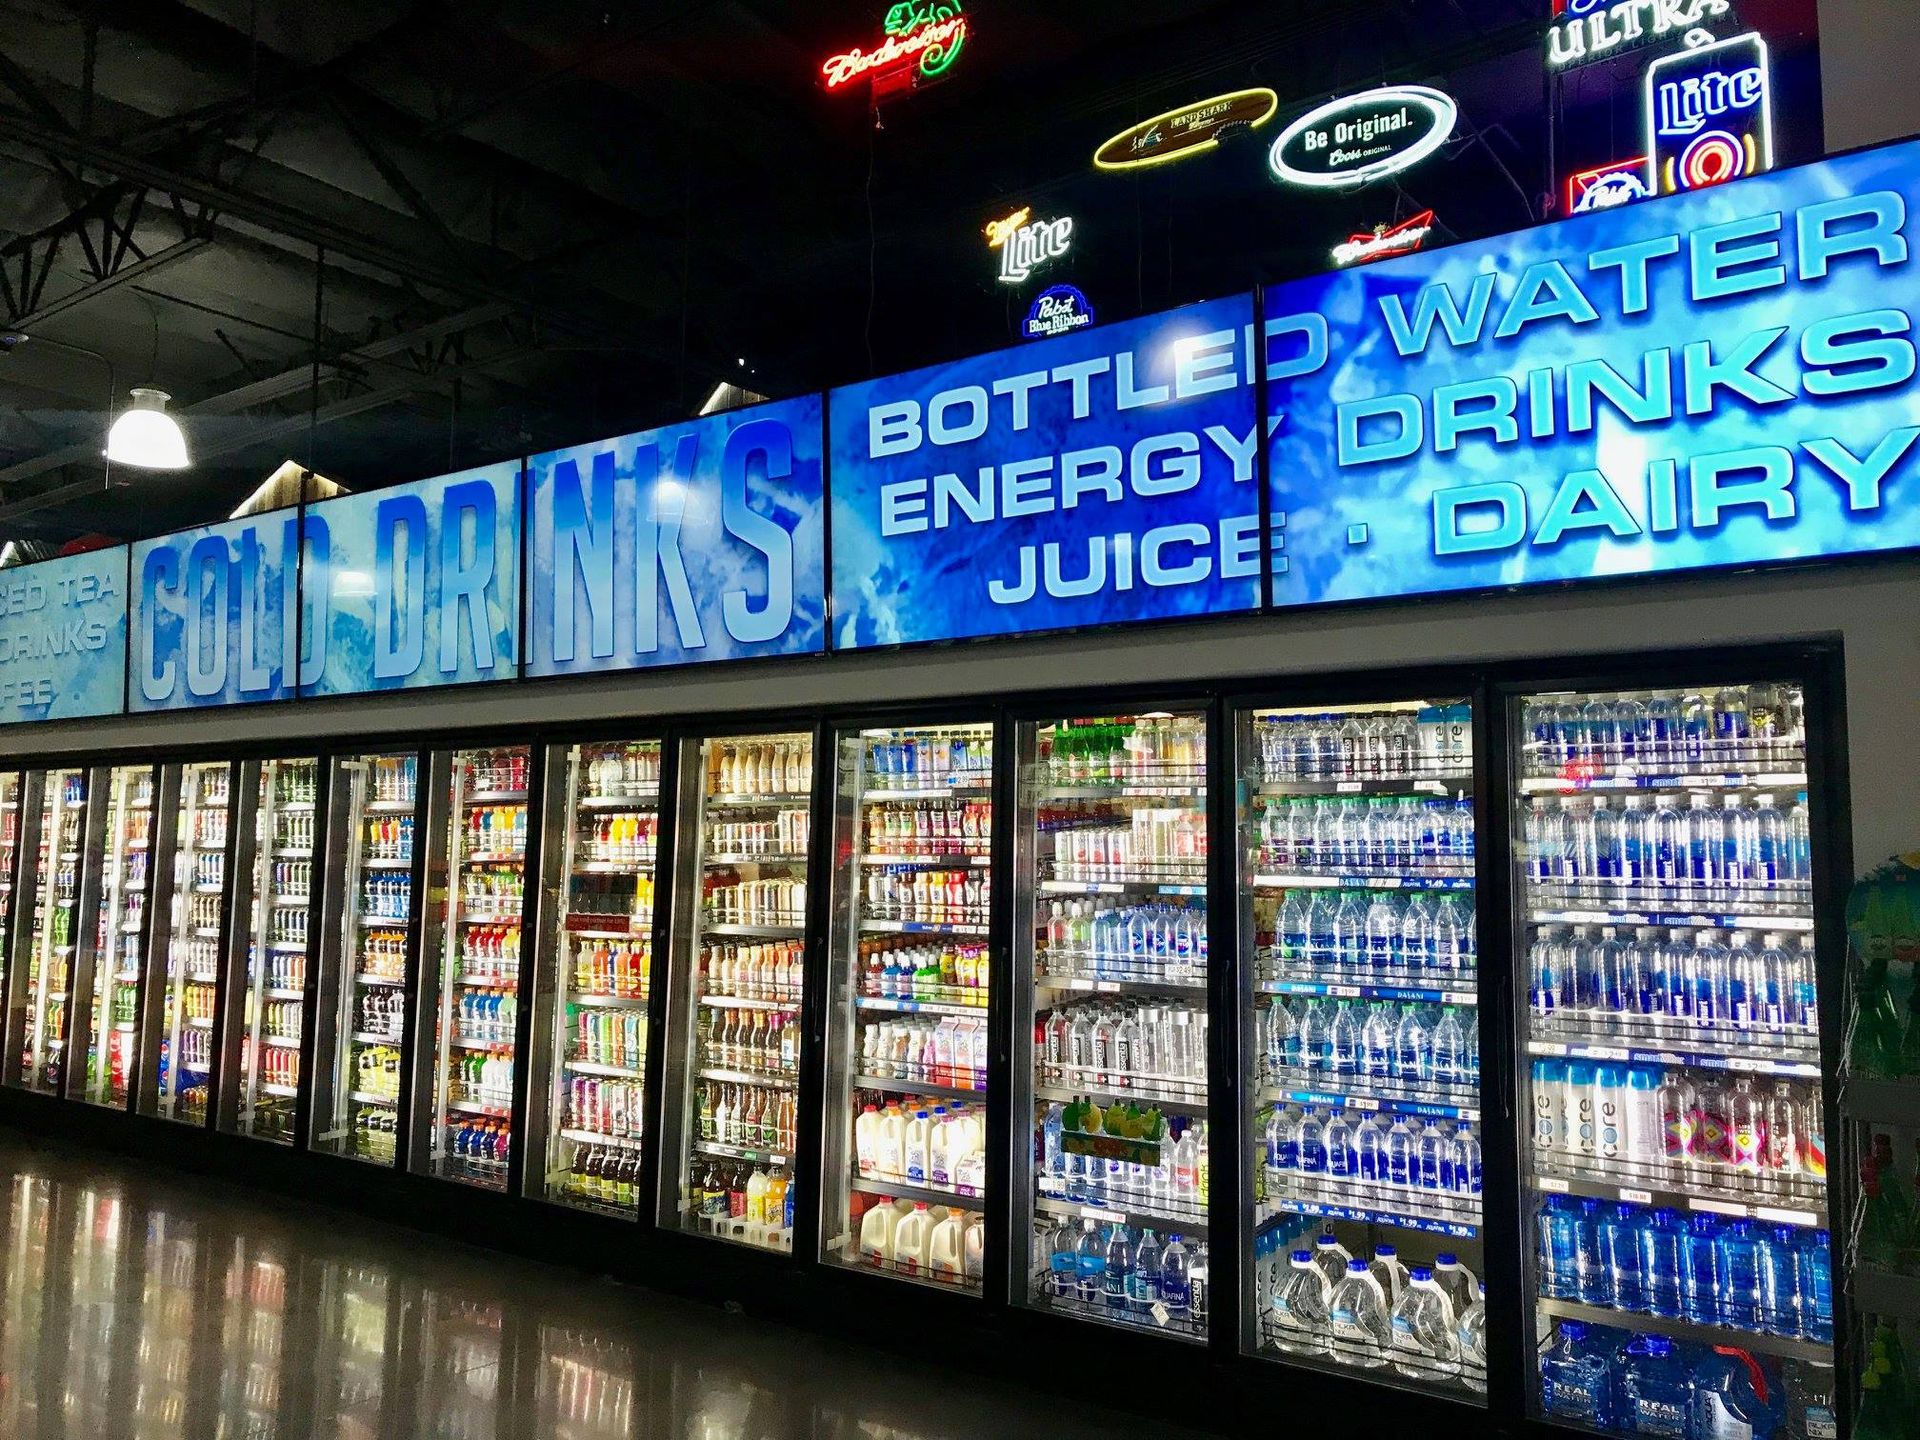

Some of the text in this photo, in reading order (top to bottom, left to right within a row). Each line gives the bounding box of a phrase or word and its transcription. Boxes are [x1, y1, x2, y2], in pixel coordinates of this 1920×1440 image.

[1659, 66, 1763, 136] Lite
[1304, 106, 1413, 151] Be Original.
[1328, 144, 1393, 166] Coors ORIGINAL
[998, 217, 1073, 282] Lite
[868, 189, 1908, 459] BOTTLED WATER
[1029, 317, 1052, 333] Blue
[1052, 313, 1089, 328] Ribbon
[1038, 295, 1075, 319] Pabst
[881, 308, 1917, 537] ENERGY DRINKS
[988, 425, 1920, 604] JUICE DAIRY
[142, 418, 794, 700] COLD DRINKS
[58, 574, 119, 606] TEA
[0, 619, 106, 663] DRINKS
[1451, 725, 1464, 764] core
[1397, 990, 1424, 1000] DASANI
[1417, 1106, 1445, 1116] DASANI
[1602, 1102, 1618, 1157] core
[1553, 1382, 1592, 1397] REAL
[1639, 1399, 1680, 1414] REAL
